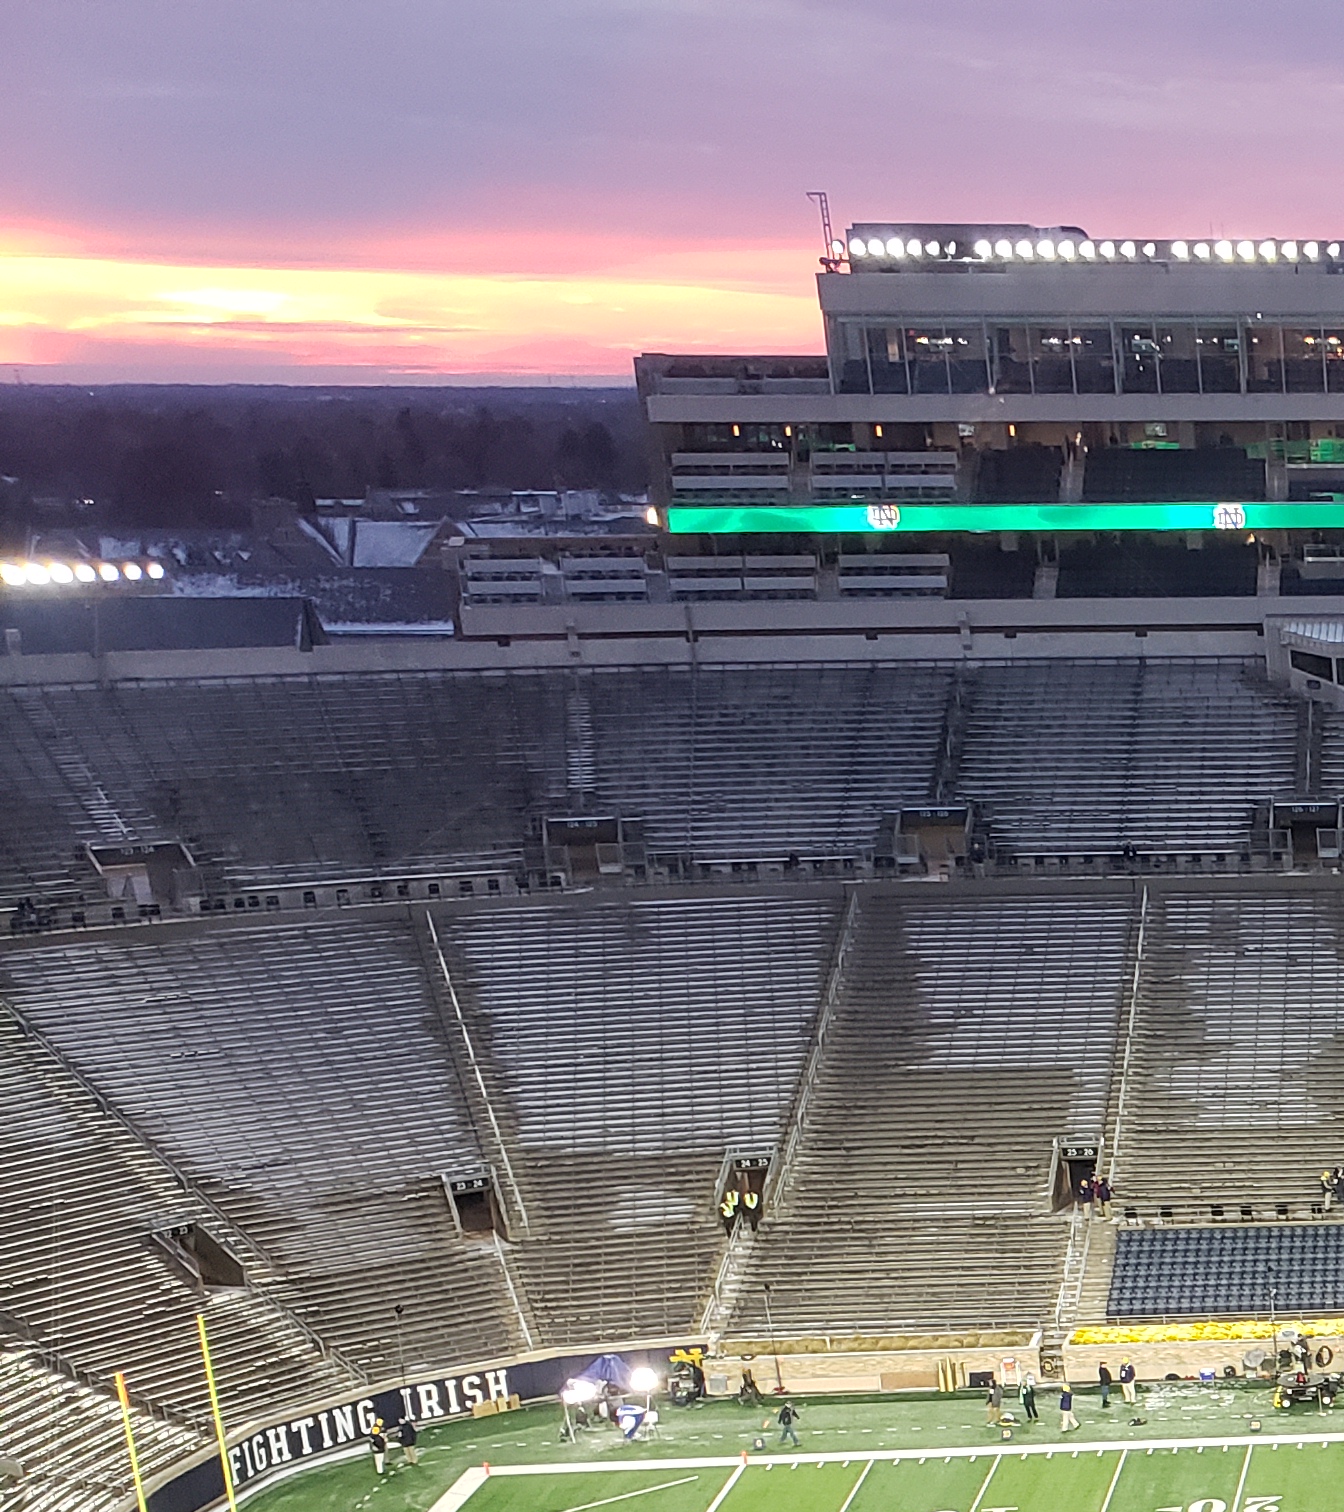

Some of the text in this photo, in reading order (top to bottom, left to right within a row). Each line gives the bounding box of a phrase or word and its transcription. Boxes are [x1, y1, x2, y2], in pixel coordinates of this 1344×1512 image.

[1067, 1148, 1094, 1156] 25 26
[741, 1158, 768, 1168] 24 25
[456, 1180, 483, 1191] 23 24
[228, 1369, 509, 1486] FIGHTING IRISH
